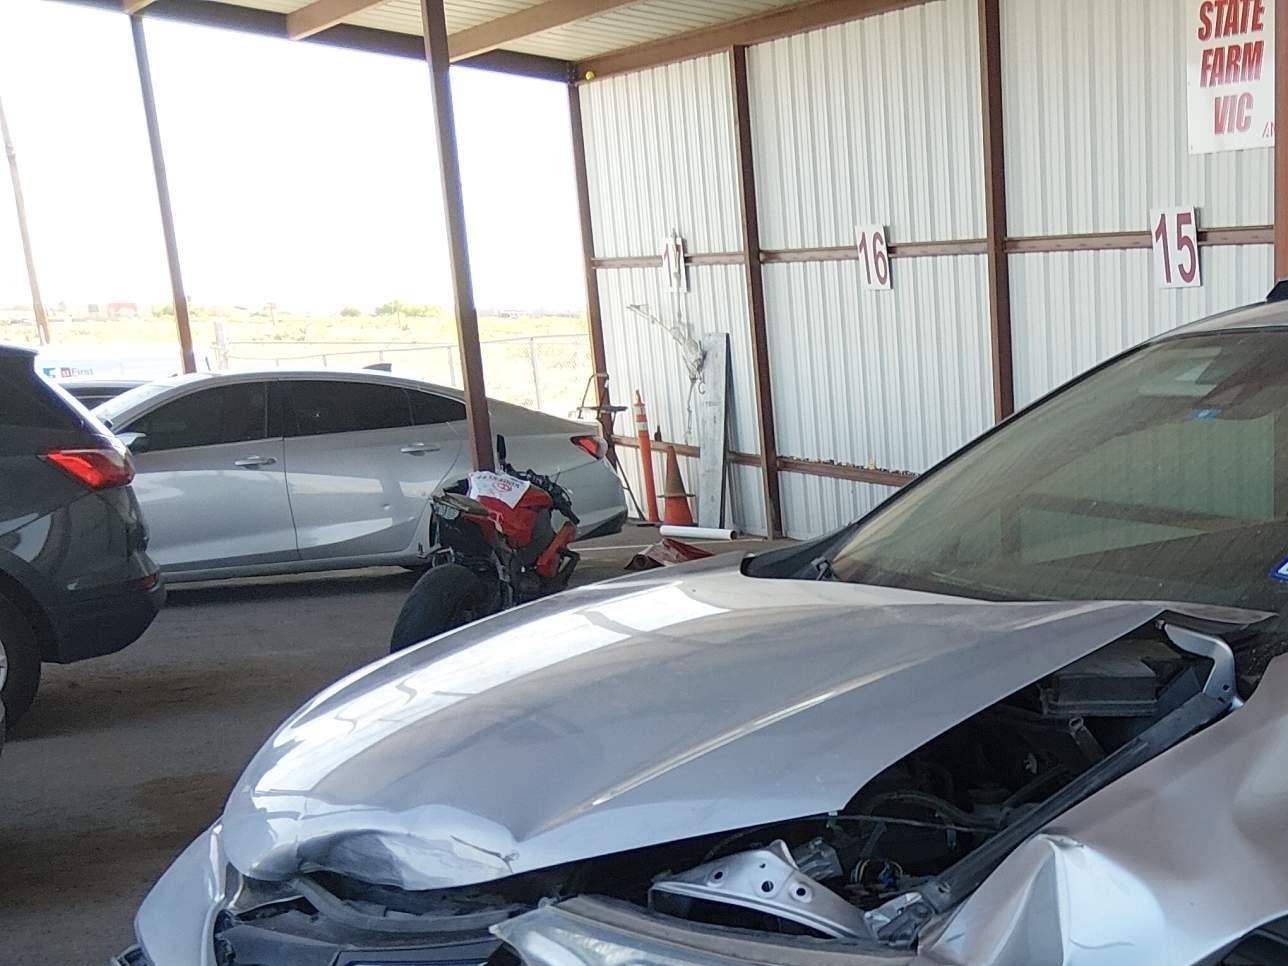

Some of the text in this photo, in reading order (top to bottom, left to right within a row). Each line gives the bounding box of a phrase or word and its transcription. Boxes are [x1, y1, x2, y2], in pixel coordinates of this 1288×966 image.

[1198, 0, 1265, 40] STATE
[1200, 40, 1264, 88] FARM
[1214, 92, 1254, 135] VIC
[859, 231, 888, 285] 16
[1155, 212, 1197, 283] 15
